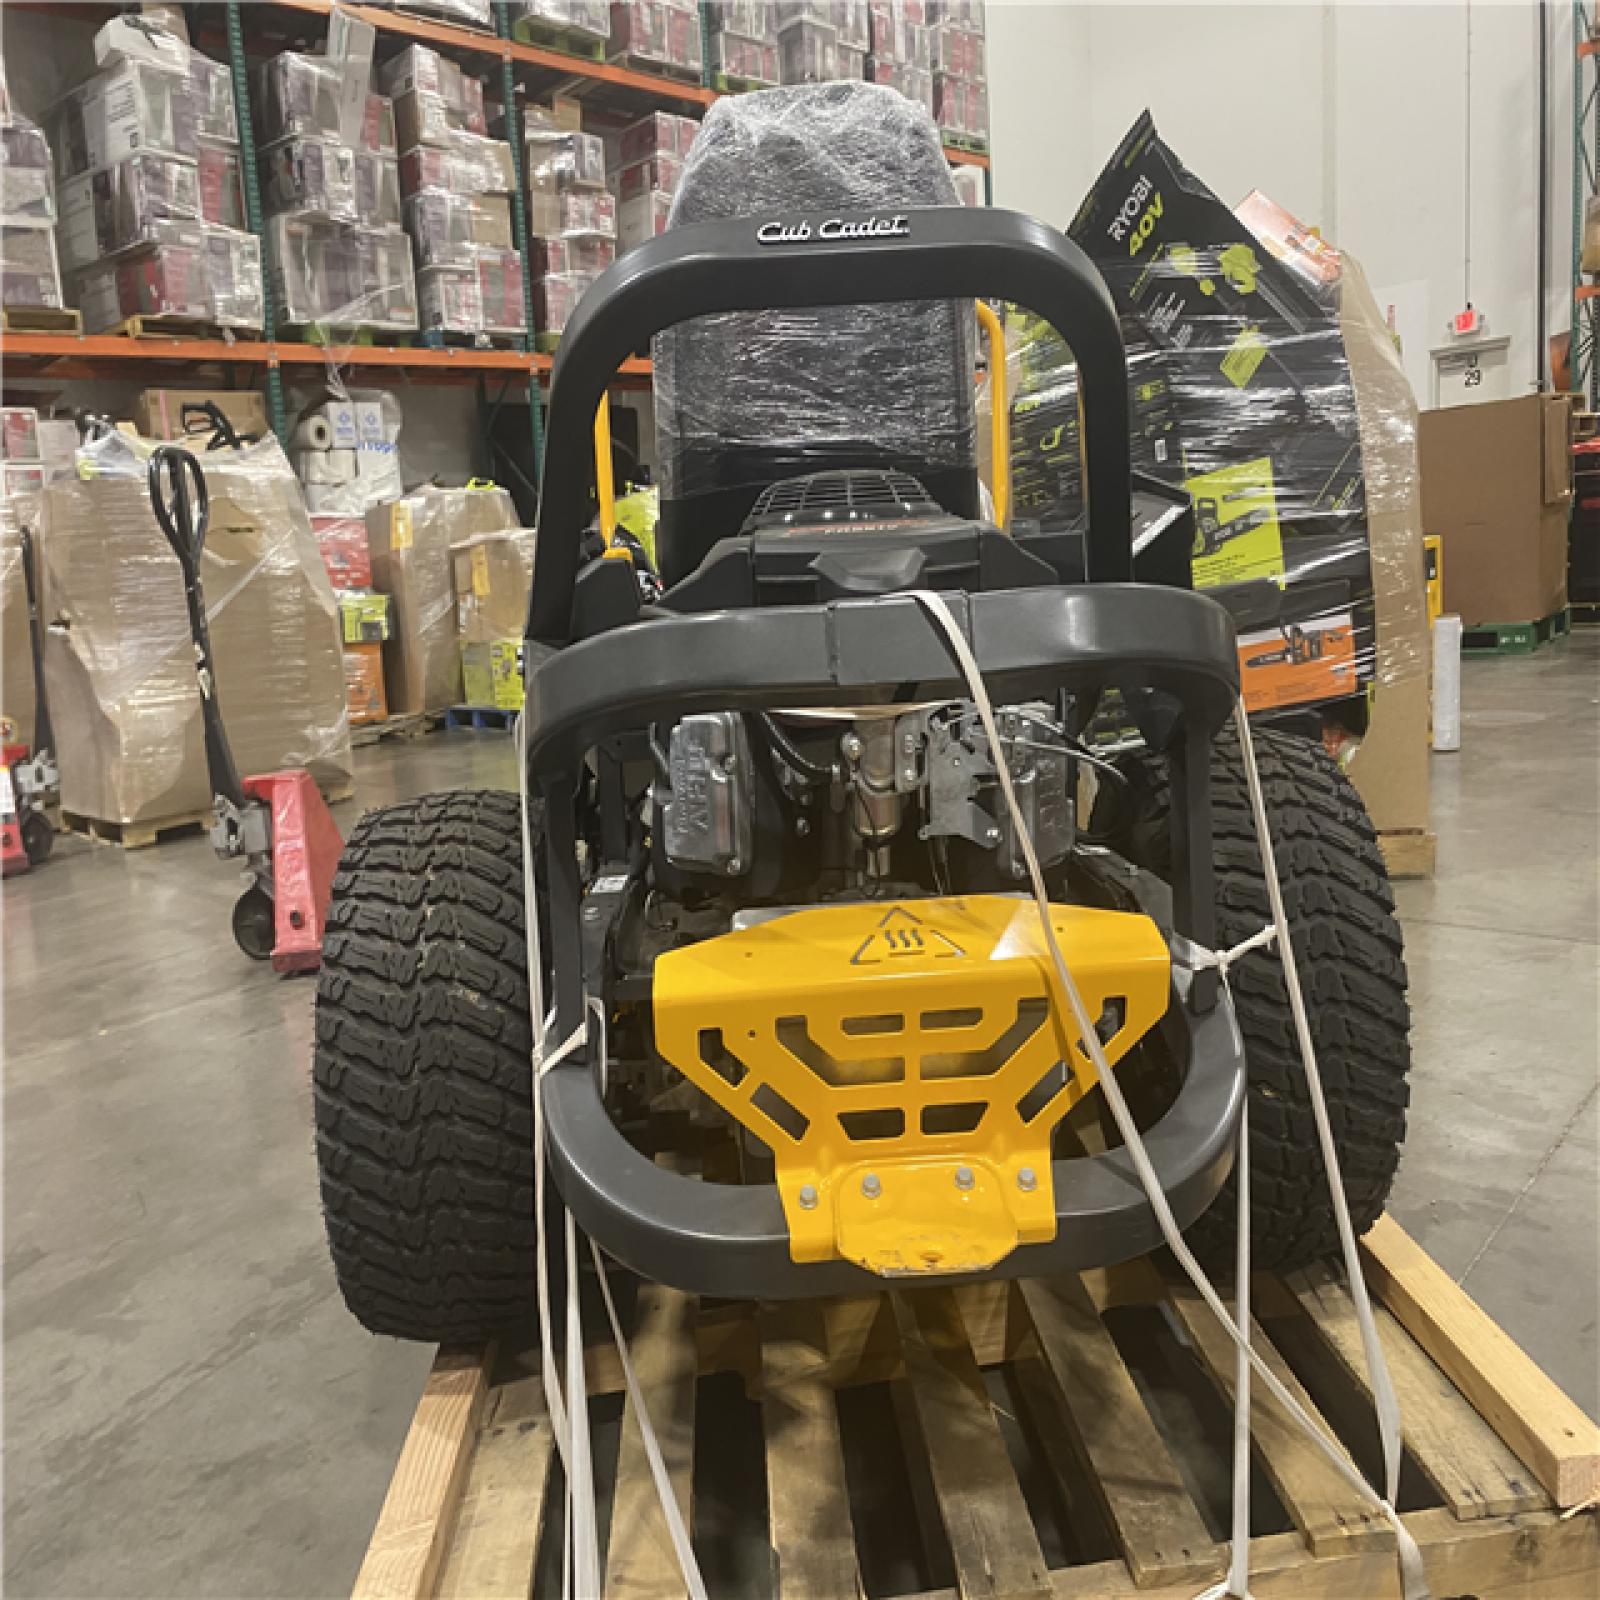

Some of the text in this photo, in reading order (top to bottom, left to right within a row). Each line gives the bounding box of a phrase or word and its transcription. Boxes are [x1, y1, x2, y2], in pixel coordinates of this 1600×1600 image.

[757, 214, 909, 242] Cub Cadet
[1107, 174, 1153, 241] RYOBI
